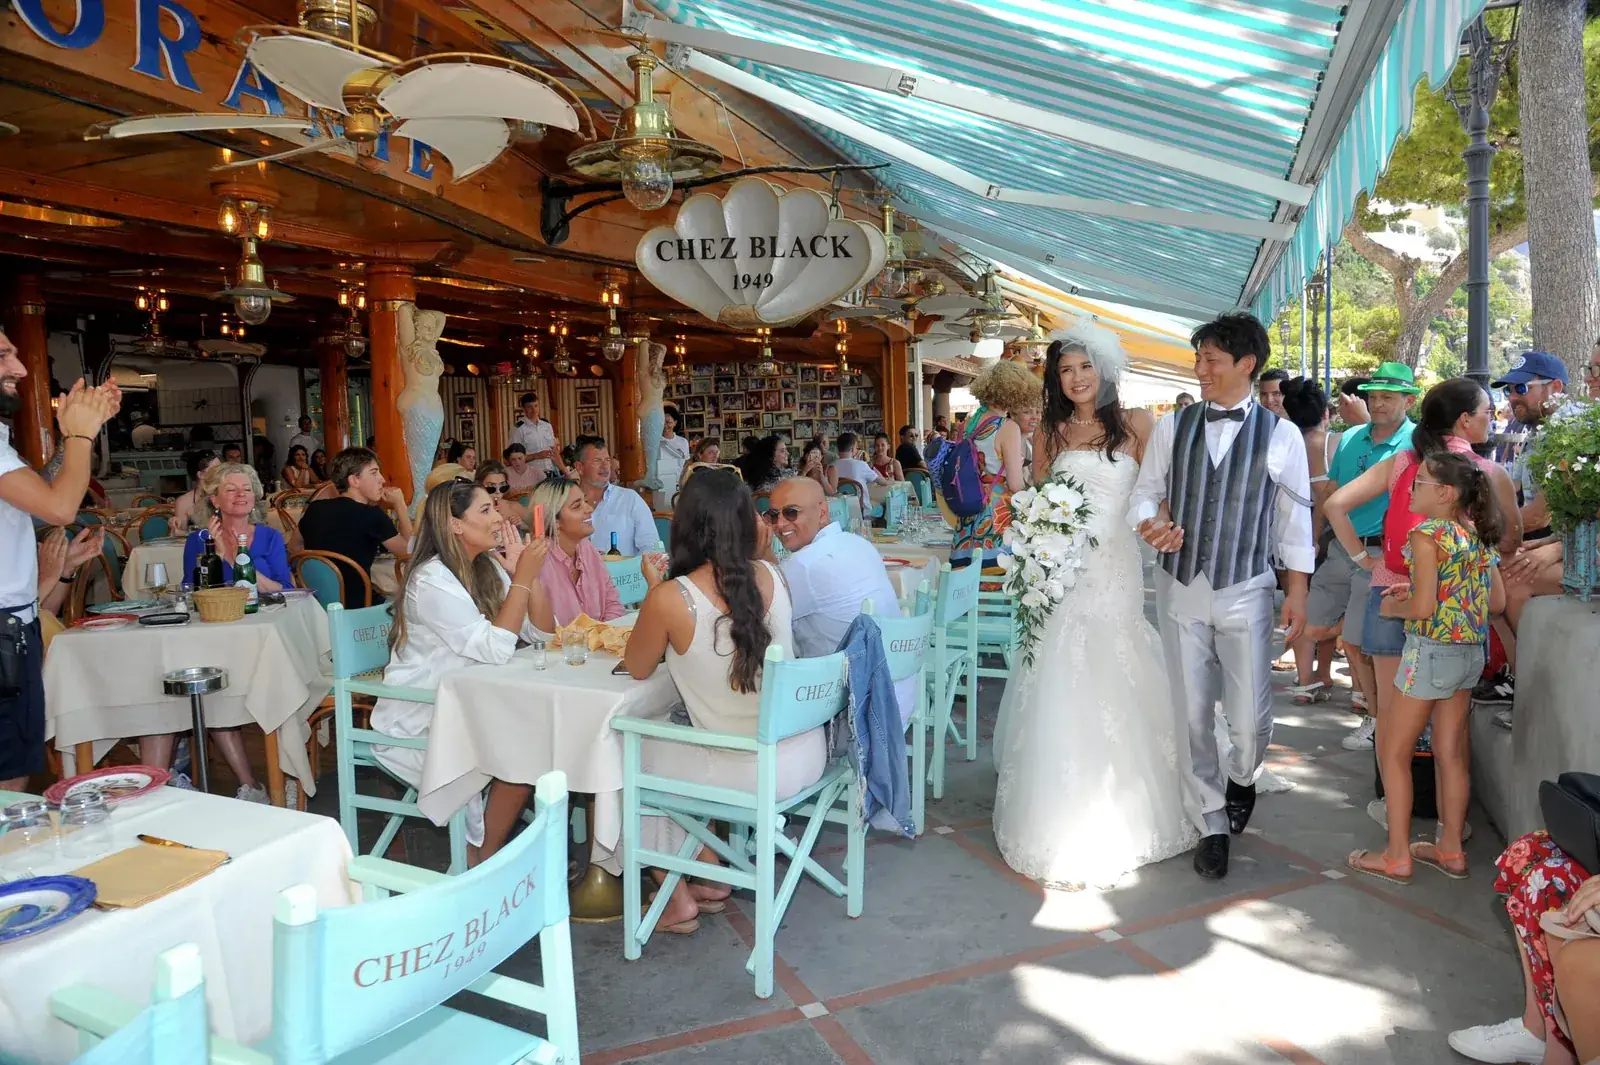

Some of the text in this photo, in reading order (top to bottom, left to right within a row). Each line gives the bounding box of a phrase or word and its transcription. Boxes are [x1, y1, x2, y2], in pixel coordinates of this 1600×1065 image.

[655, 234, 853, 262] CHEZ BLACK
[732, 272, 774, 290] 1949
[353, 626, 378, 643] CHEZ
[890, 637, 921, 653] CHEZ
[795, 681, 834, 702] CHEZ
[353, 866, 537, 988] CHEZ BLACK
[444, 941, 487, 979] 1949
